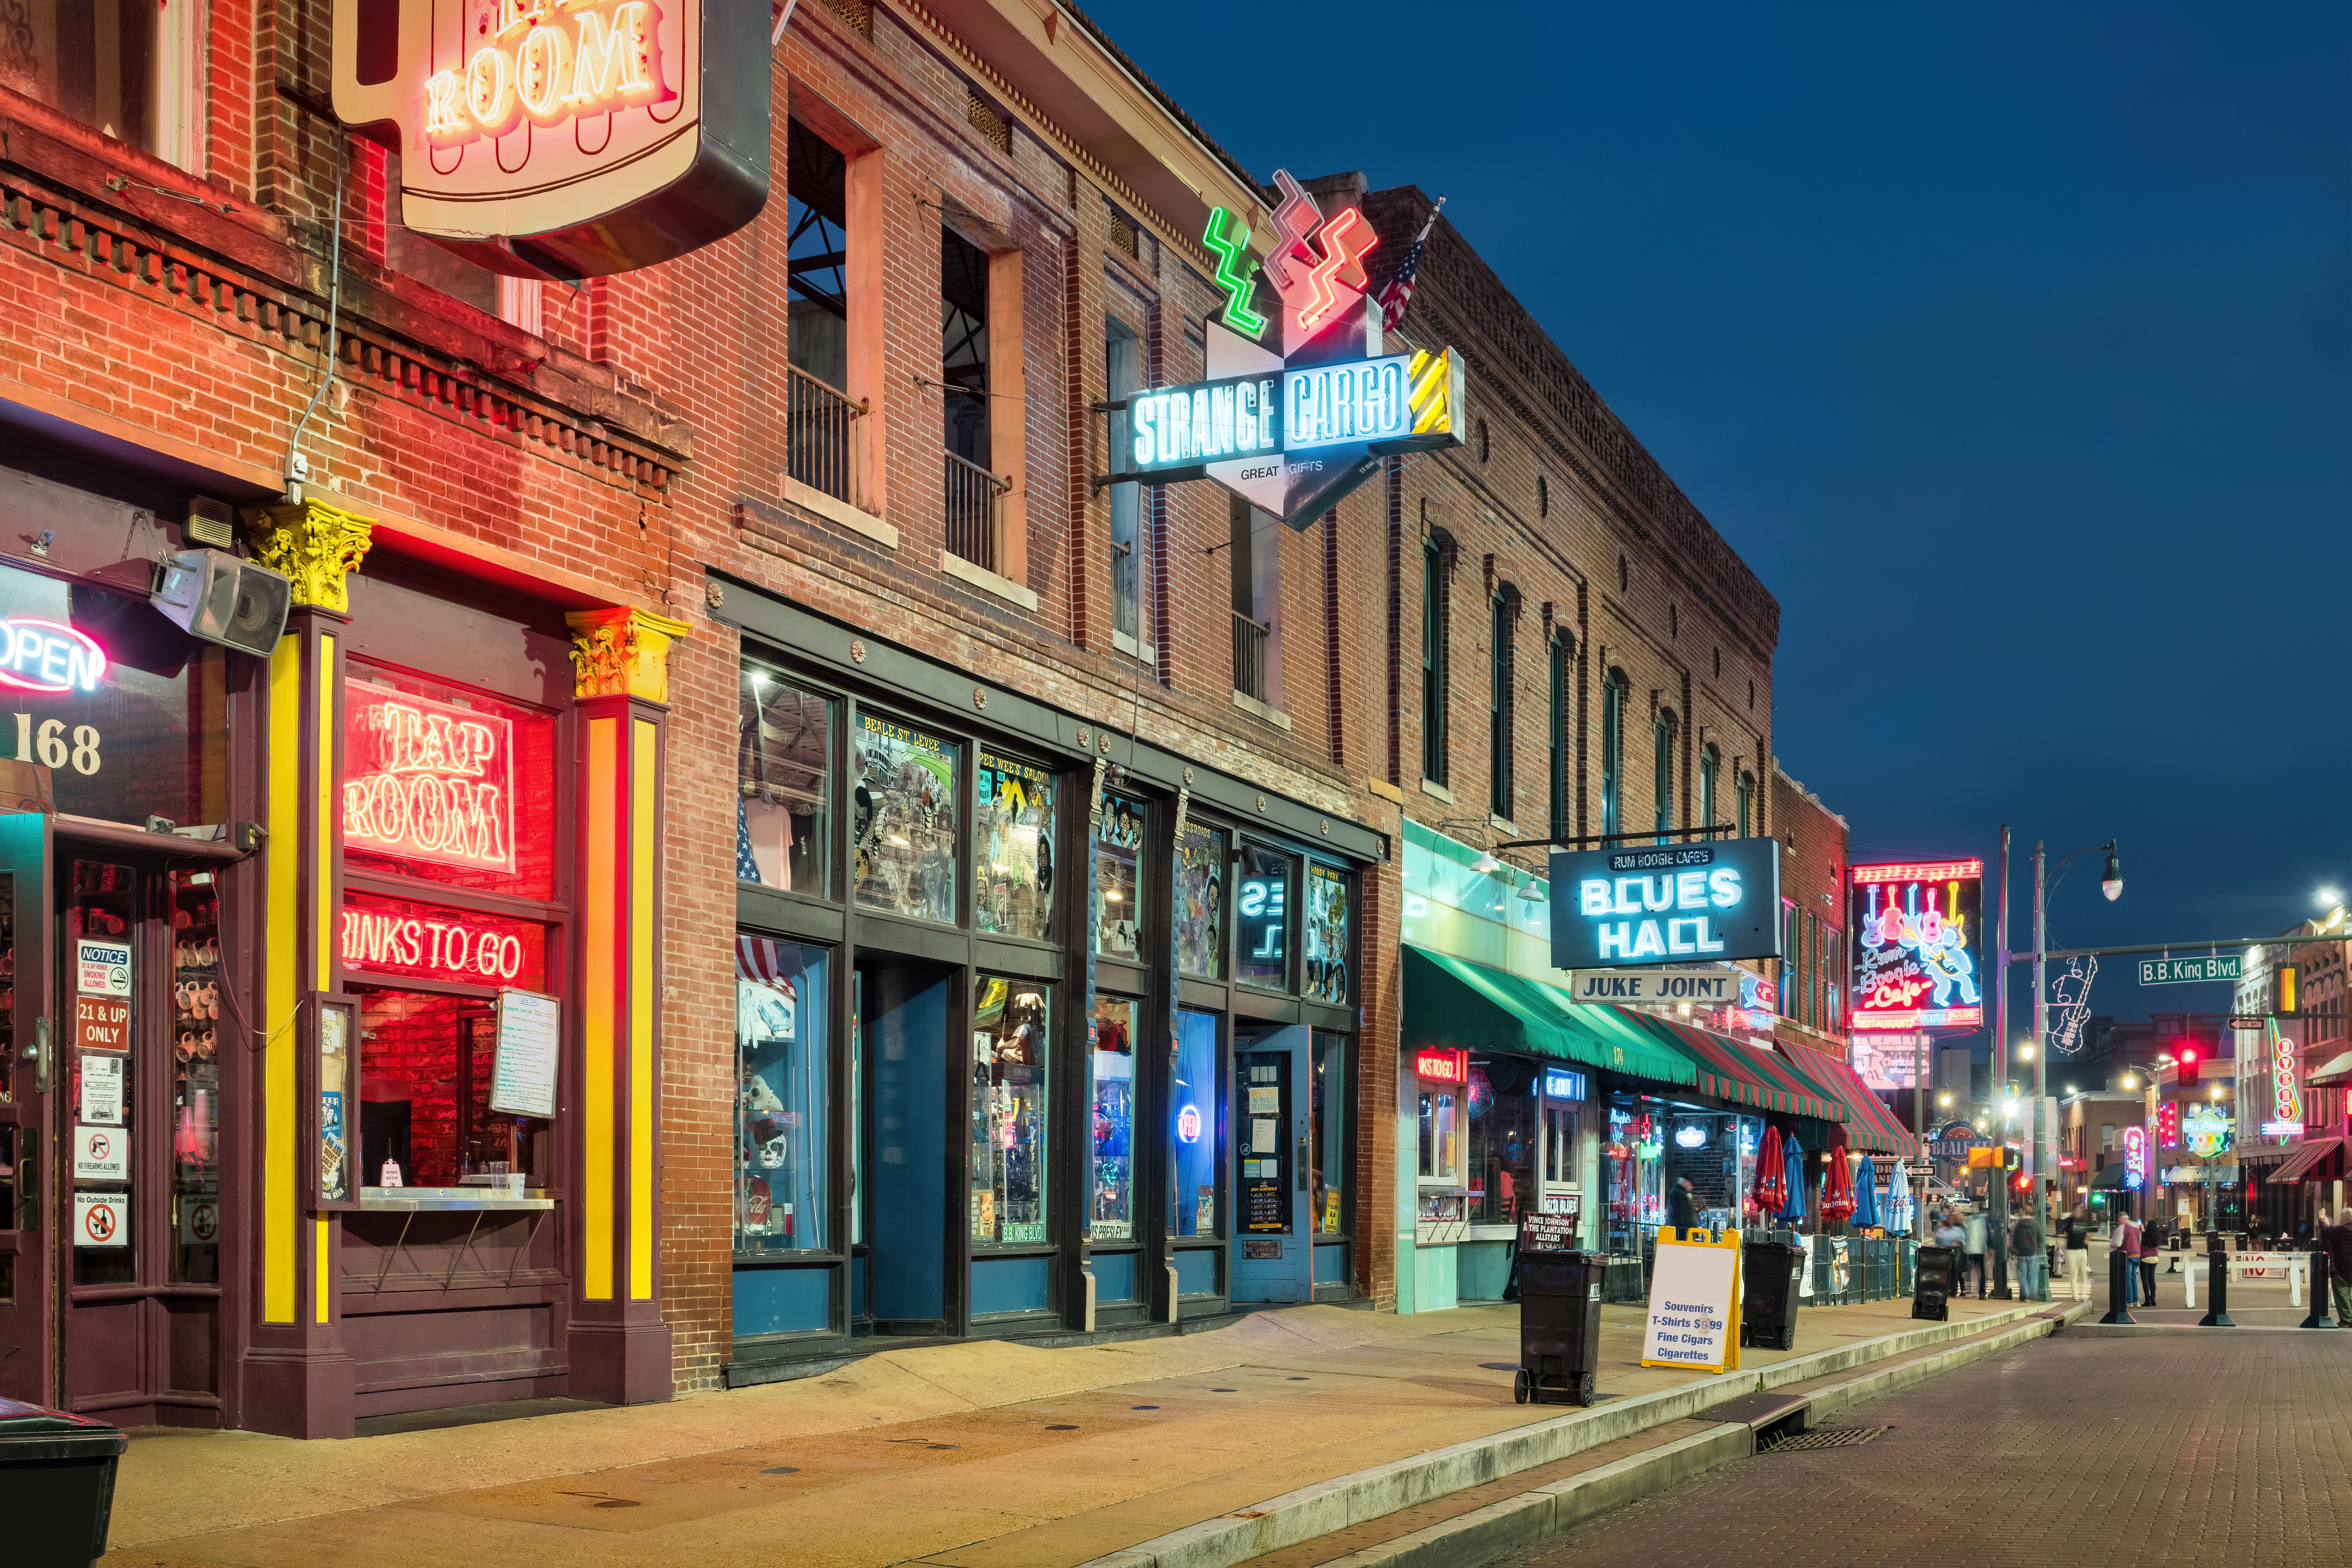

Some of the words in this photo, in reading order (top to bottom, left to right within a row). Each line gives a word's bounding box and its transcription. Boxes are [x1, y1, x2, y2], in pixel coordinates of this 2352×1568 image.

[423, 1, 664, 140] ROOM
[1135, 379, 1274, 464] STRANGE
[1291, 364, 1402, 443] CARGO
[1241, 466, 1279, 480] GREAT
[1289, 460, 1323, 474] GIFTS
[0, 620, 97, 691] OPEN
[385, 703, 493, 776] TAP
[865, 716, 894, 737] BEALE
[897, 728, 910, 743] ST.
[914, 732, 939, 751] LEVEE
[13, 713, 100, 775] 168
[980, 752, 994, 767] PEE
[997, 758, 1021, 776] WEE'S
[1024, 767, 1050, 785] SALOON
[343, 774, 505, 862] ROOM
[1614, 856, 1635, 869] RUM
[1638, 853, 1673, 866] BOOGIE
[1677, 850, 1709, 865] CAFE'S
[1311, 865, 1325, 877] HANDY
[1327, 870, 1339, 882] PARK
[1581, 868, 1742, 915] BLUES
[1599, 916, 1724, 959] HALL
[82, 948, 125, 963] NOTICE
[425, 924, 467, 969] TO
[478, 933, 520, 978] GO
[1862, 946, 1907, 972] Rum
[84, 971, 105, 979] SMOKING
[1861, 959, 1920, 994] Boogie
[2143, 963, 2172, 981] B.B.
[2175, 961, 2202, 979] King
[2207, 959, 2240, 977] Blvd.
[84, 979, 106, 988] ALLOWED
[1583, 977, 1642, 997] JUKE
[1655, 977, 1727, 997] JOINT
[1875, 980, 1922, 1007] Cafe
[79, 1004, 94, 1020] 21
[98, 1005, 107, 1021] &
[110, 1007, 126, 1023] UP
[1953, 1008, 1975, 1018] CLUB
[1857, 1019, 1911, 1028] RESTAURANT
[86, 1025, 119, 1043] ONLY
[1014, 1067, 1032, 1076] ENCORE
[1433, 1059, 1442, 1077] TO
[1442, 1060, 1453, 1078] GO
[323, 1147, 337, 1163] BEERS
[332, 1143, 342, 1156] ASS
[1932, 1141, 1969, 1155] BEALE
[332, 1188, 344, 1199] BEER
[1560, 1199, 1577, 1214] BLUES
[1523, 1222, 1527, 1231] &
[1540, 1226, 1573, 1235] PLANTATION
[1528, 1216, 1544, 1224] VINCE
[1545, 1217, 1569, 1226] JOHNSON
[1004, 1227, 1014, 1241] B.B.
[1015, 1226, 1028, 1240] KING
[1029, 1226, 1042, 1240] BLVD
[1099, 1225, 1124, 1239] PRESLEY
[1536, 1233, 1560, 1242] ALLSTARS
[2245, 1255, 2265, 1276] NO
[1665, 1301, 1714, 1314] Souvenirs
[1653, 1316, 1691, 1328] T-Shirts
[1658, 1332, 1678, 1342] Fine
[1681, 1334, 1713, 1346] Cigars
[1658, 1348, 1709, 1360] Cigarettes
